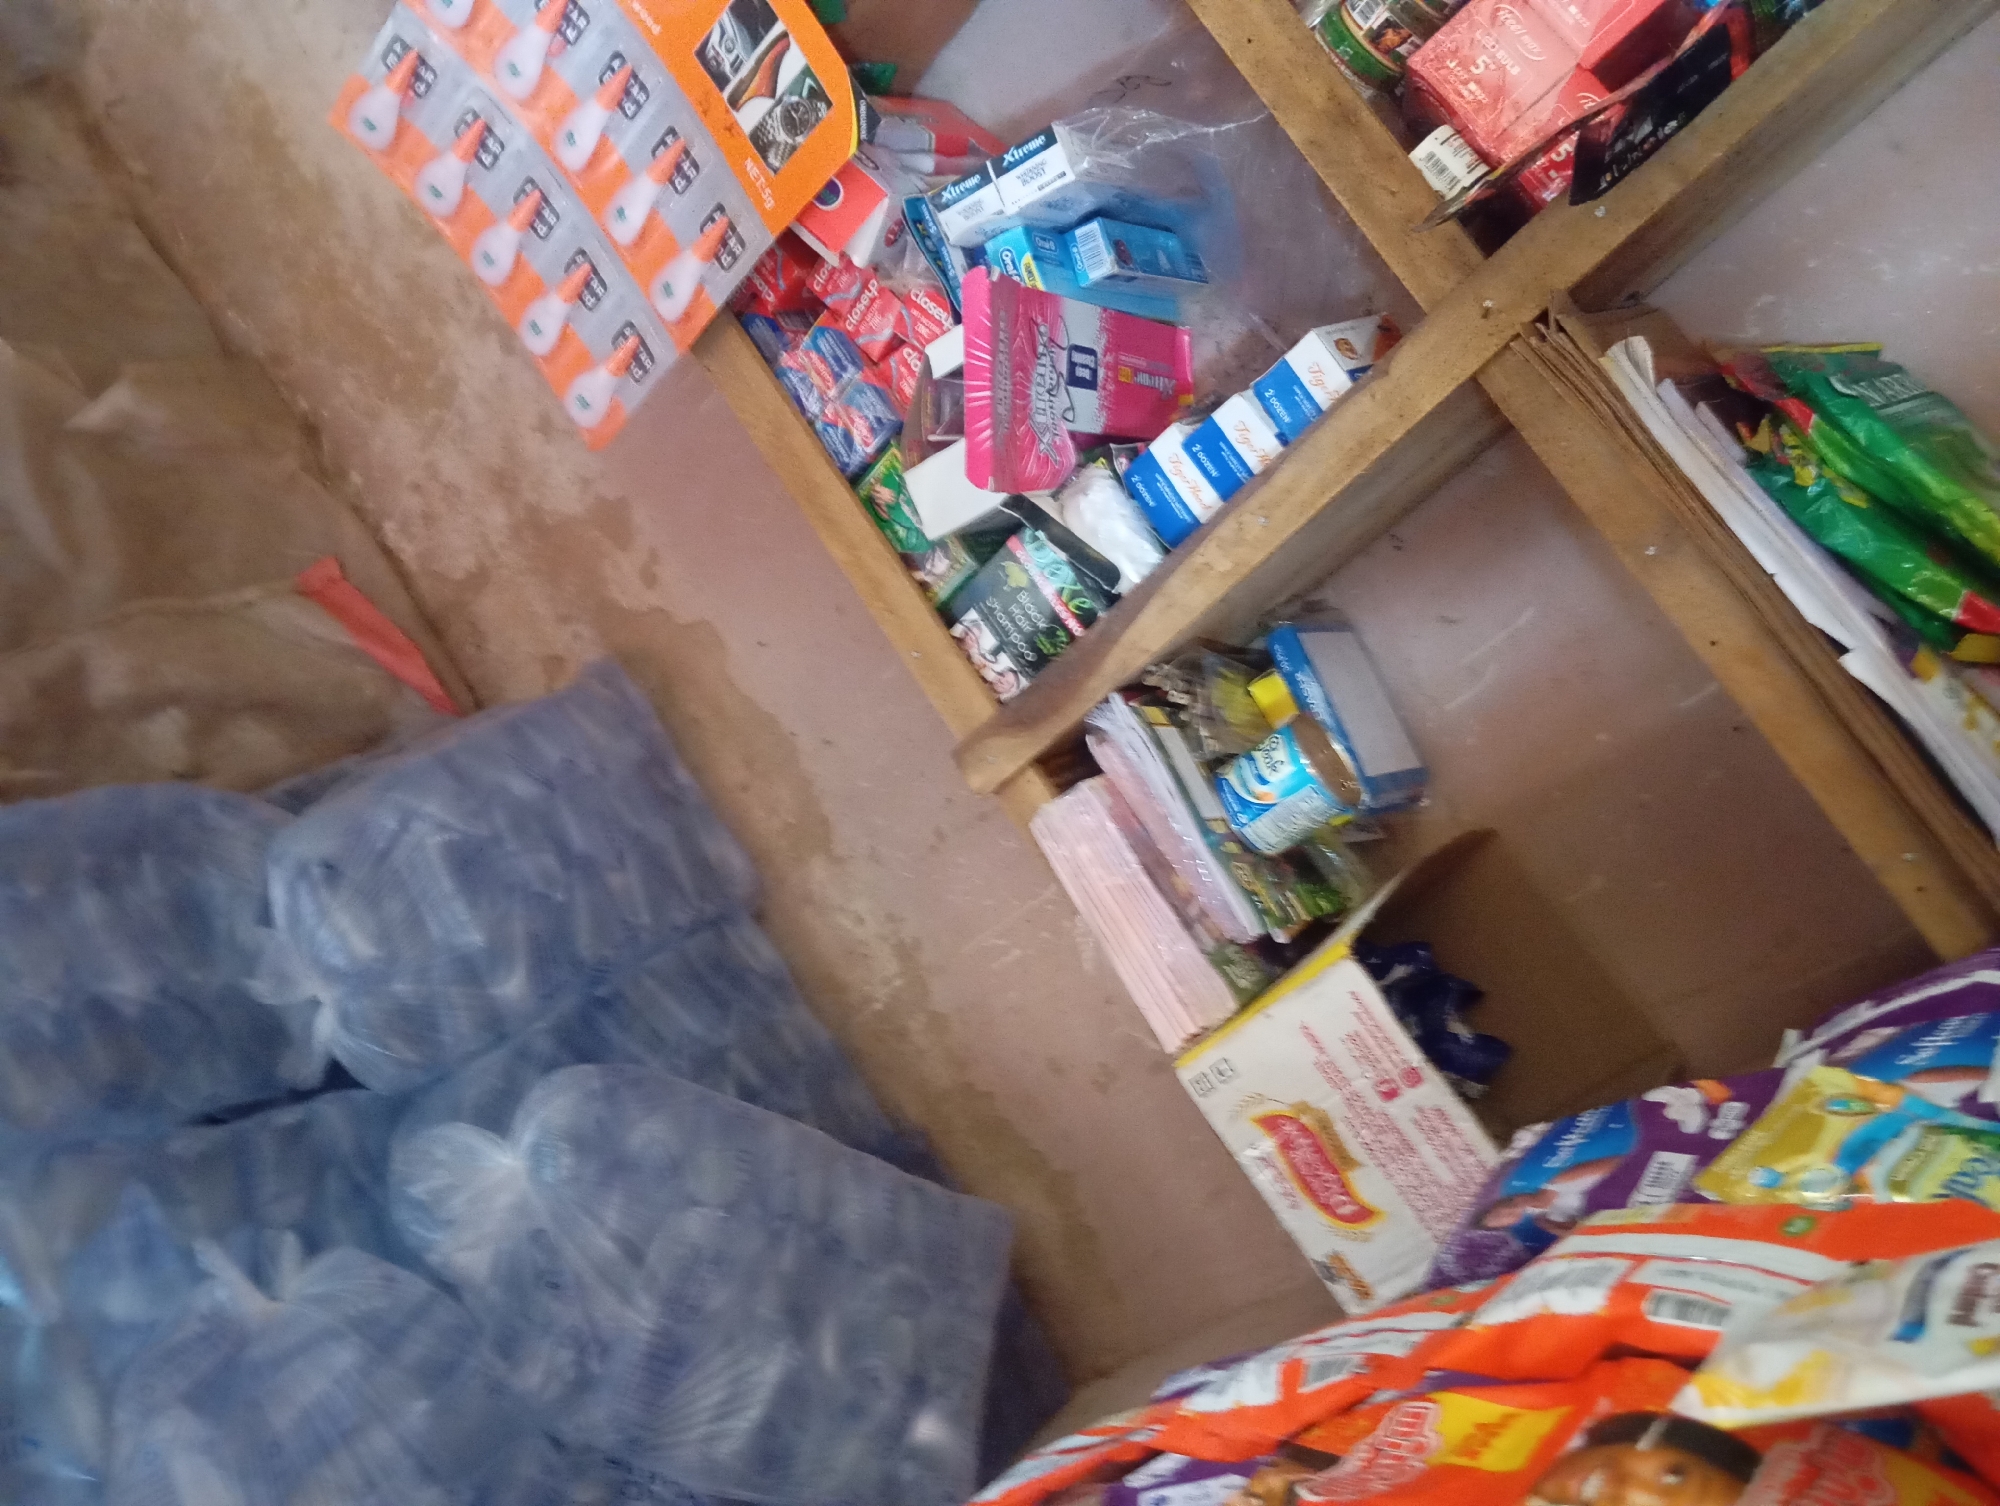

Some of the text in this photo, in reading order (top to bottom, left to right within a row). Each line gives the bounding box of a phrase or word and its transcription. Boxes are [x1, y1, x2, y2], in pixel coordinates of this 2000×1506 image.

[1496, 51, 1521, 75] BULB
[1002, 133, 1046, 167] Xtreme
[941, 173, 981, 203] Xtreme
[1020, 168, 1046, 187] BOOST
[845, 279, 878, 331] closeup
[1270, 397, 1291, 423] DOZEN
[1168, 452, 1193, 491] Tiger
[1198, 452, 1219, 478] DOZEN
[1137, 483, 1157, 507] DOZEN
[1008, 604, 1034, 633] Hair
[1016, 590, 1047, 629] Black
